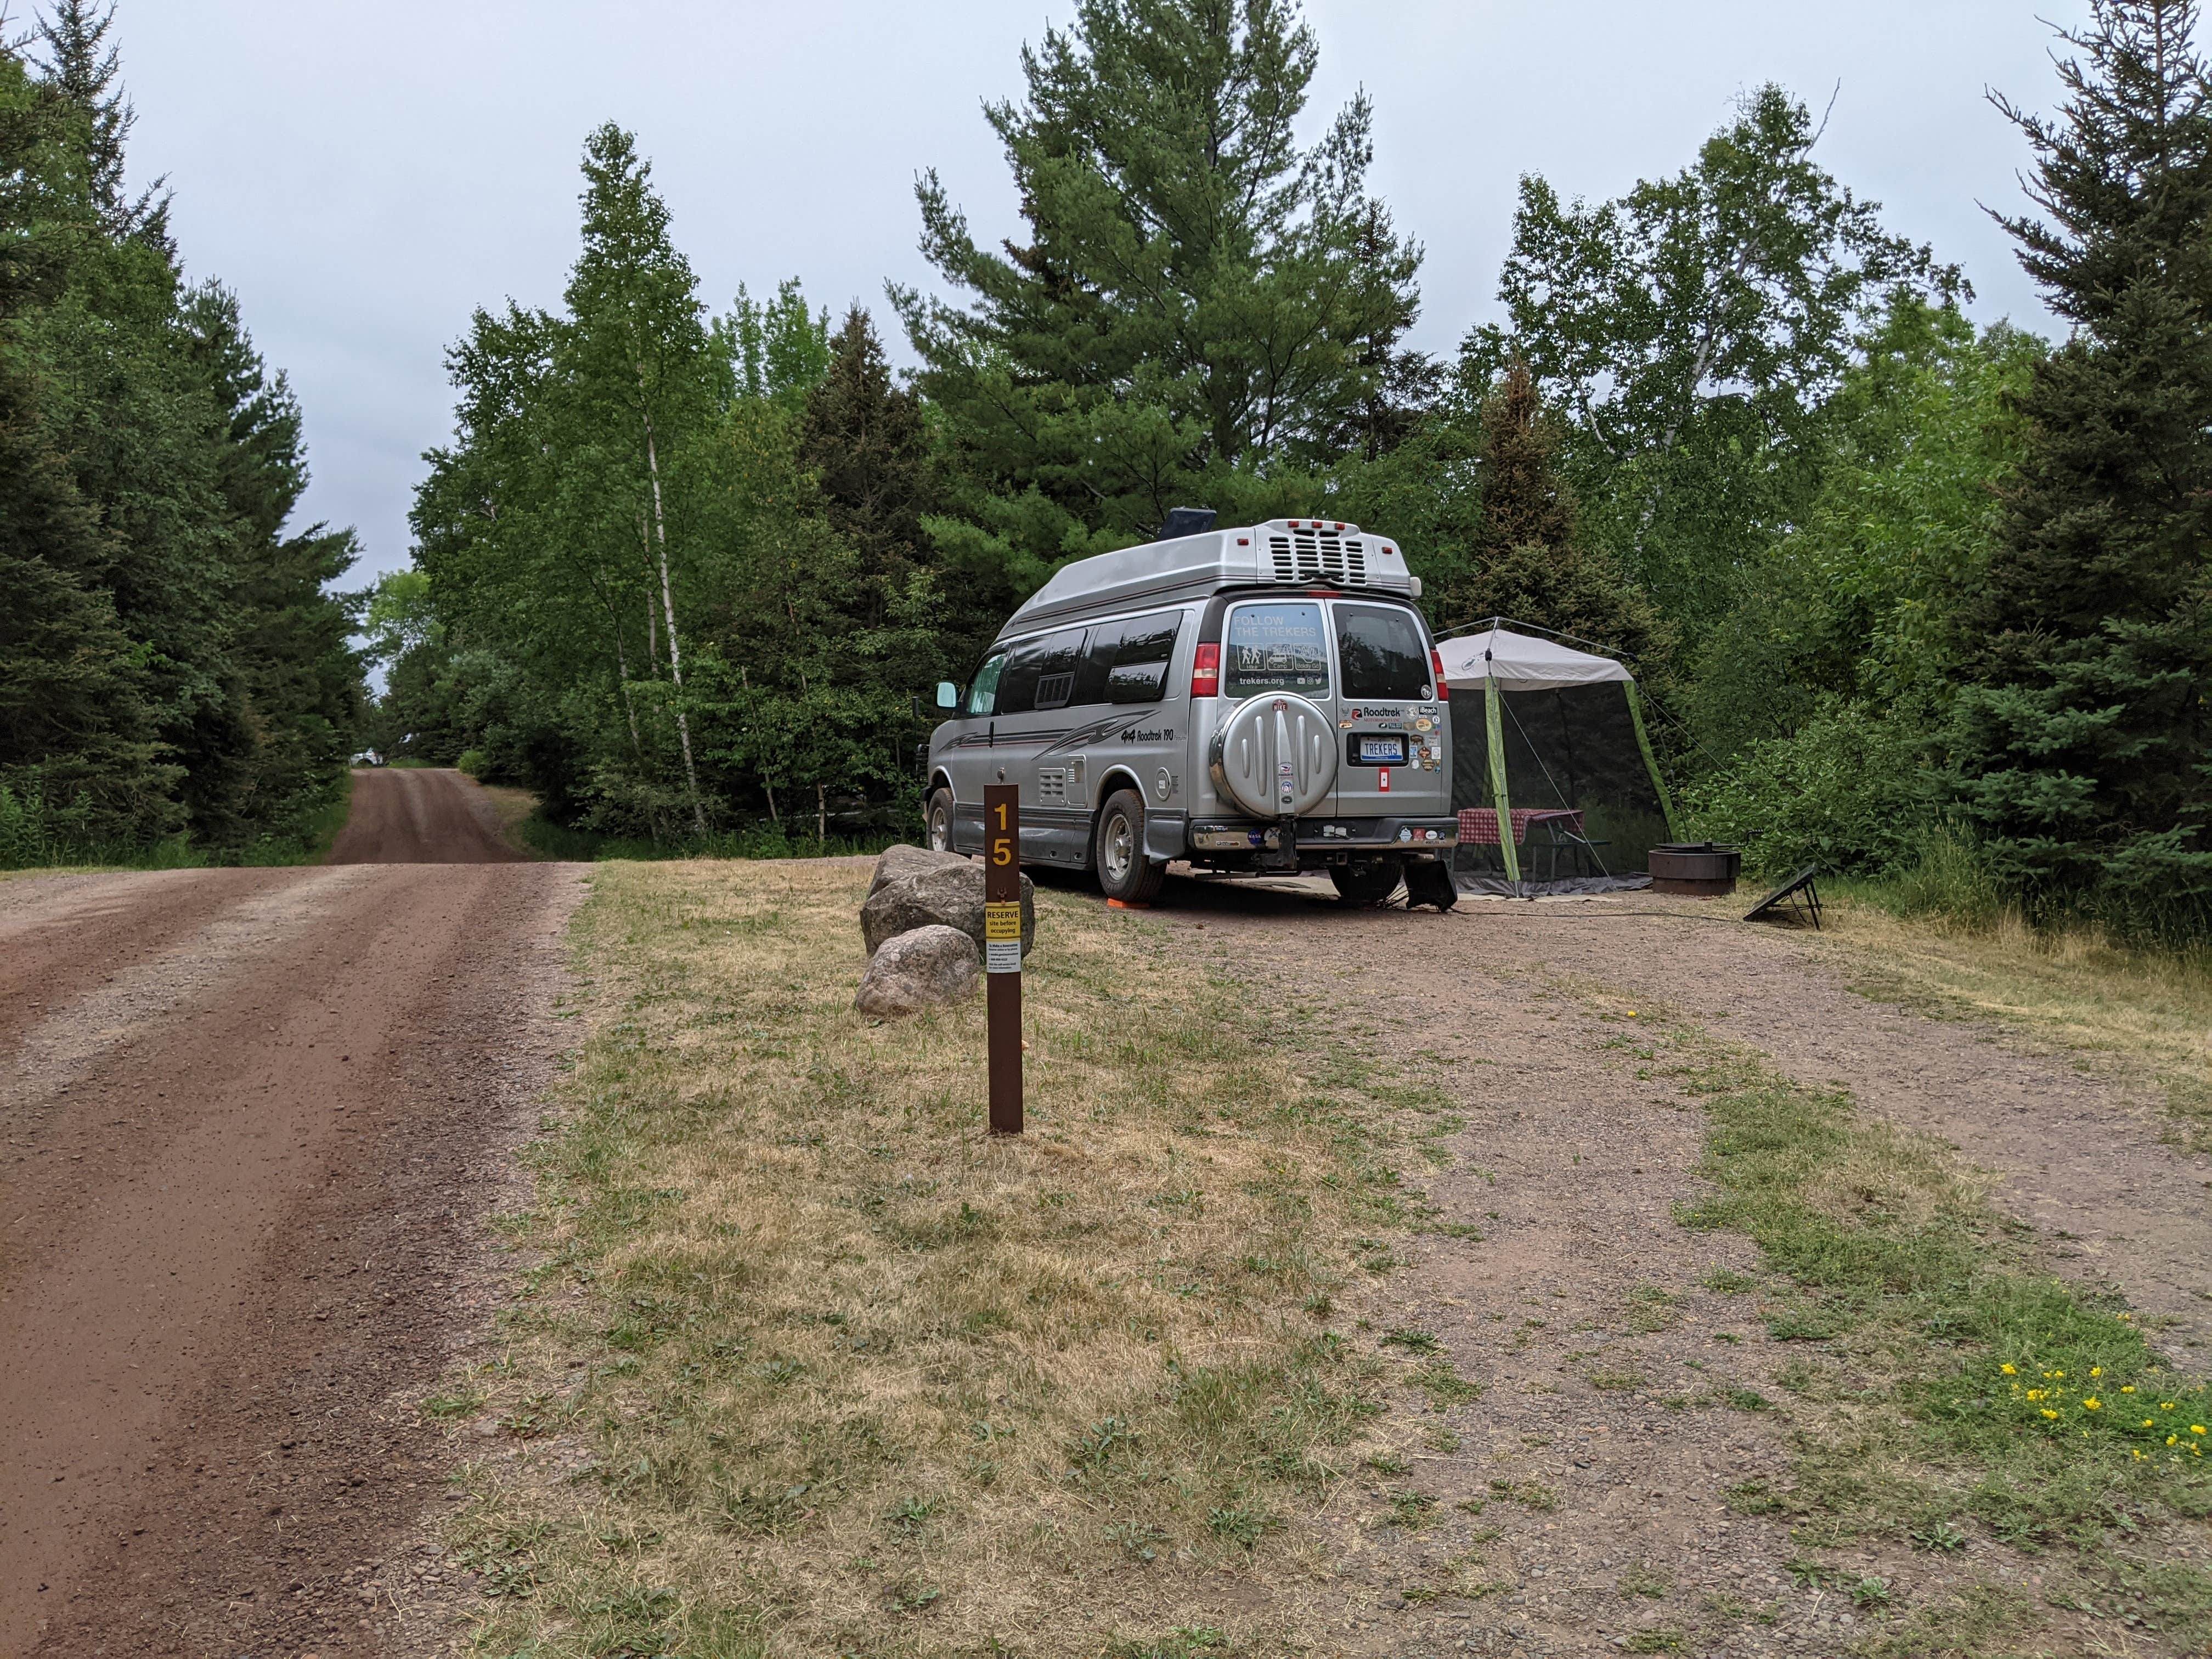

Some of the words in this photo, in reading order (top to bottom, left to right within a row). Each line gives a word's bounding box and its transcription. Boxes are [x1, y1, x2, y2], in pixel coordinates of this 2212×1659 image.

[1234, 616, 1283, 625] FOLLOW
[1235, 627, 1259, 637] THE
[1262, 627, 1316, 637] TREKERS
[1240, 678, 1284, 686] trekers.org
[1364, 707, 1400, 716] Roadtrek
[1121, 729, 1136, 744] 4x4
[1137, 729, 1161, 742] Roadtrek
[1164, 729, 1173, 741] 190
[1365, 743, 1397, 755] TREKERS
